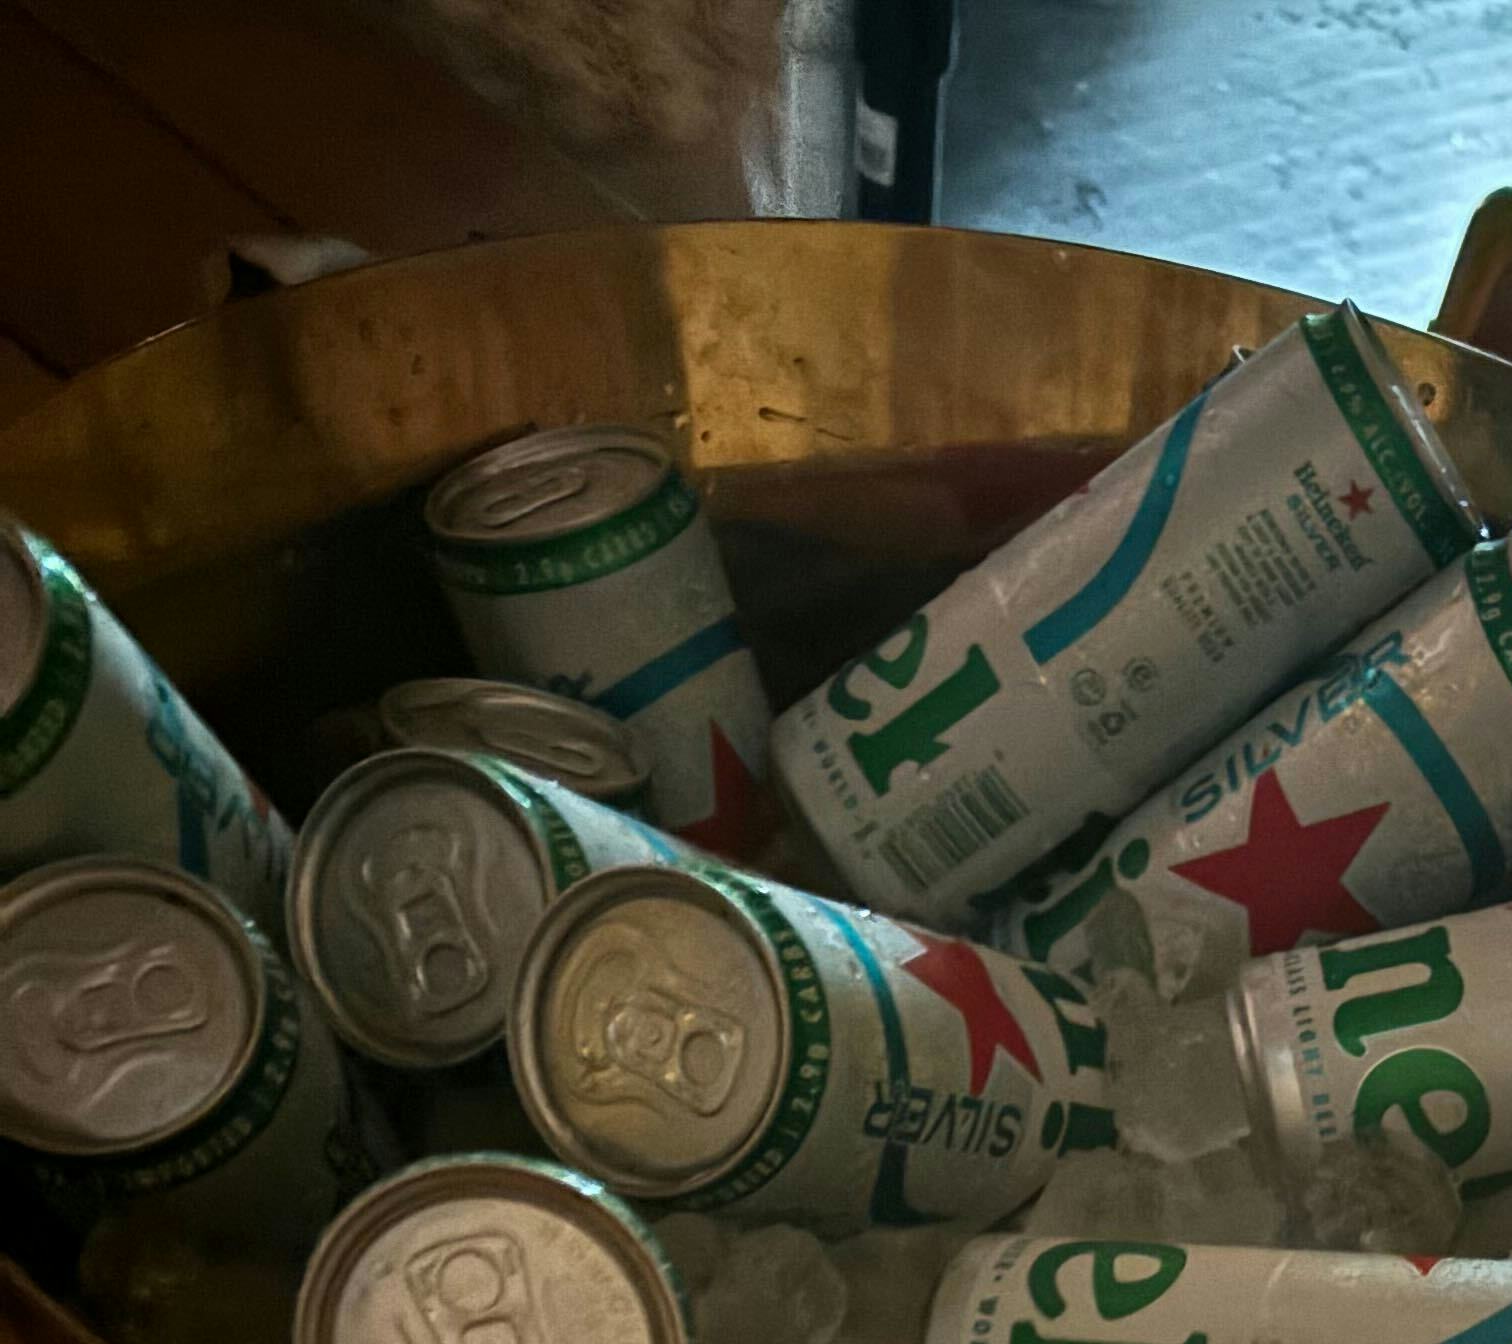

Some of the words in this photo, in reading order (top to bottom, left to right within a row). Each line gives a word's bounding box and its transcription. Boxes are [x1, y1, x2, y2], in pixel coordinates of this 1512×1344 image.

[1293, 459, 1375, 572] Heineken
[1178, 630, 1412, 824] SILVER
[860, 1078, 1026, 1160] SILVER
[1308, 1090, 1337, 1144] BEE
